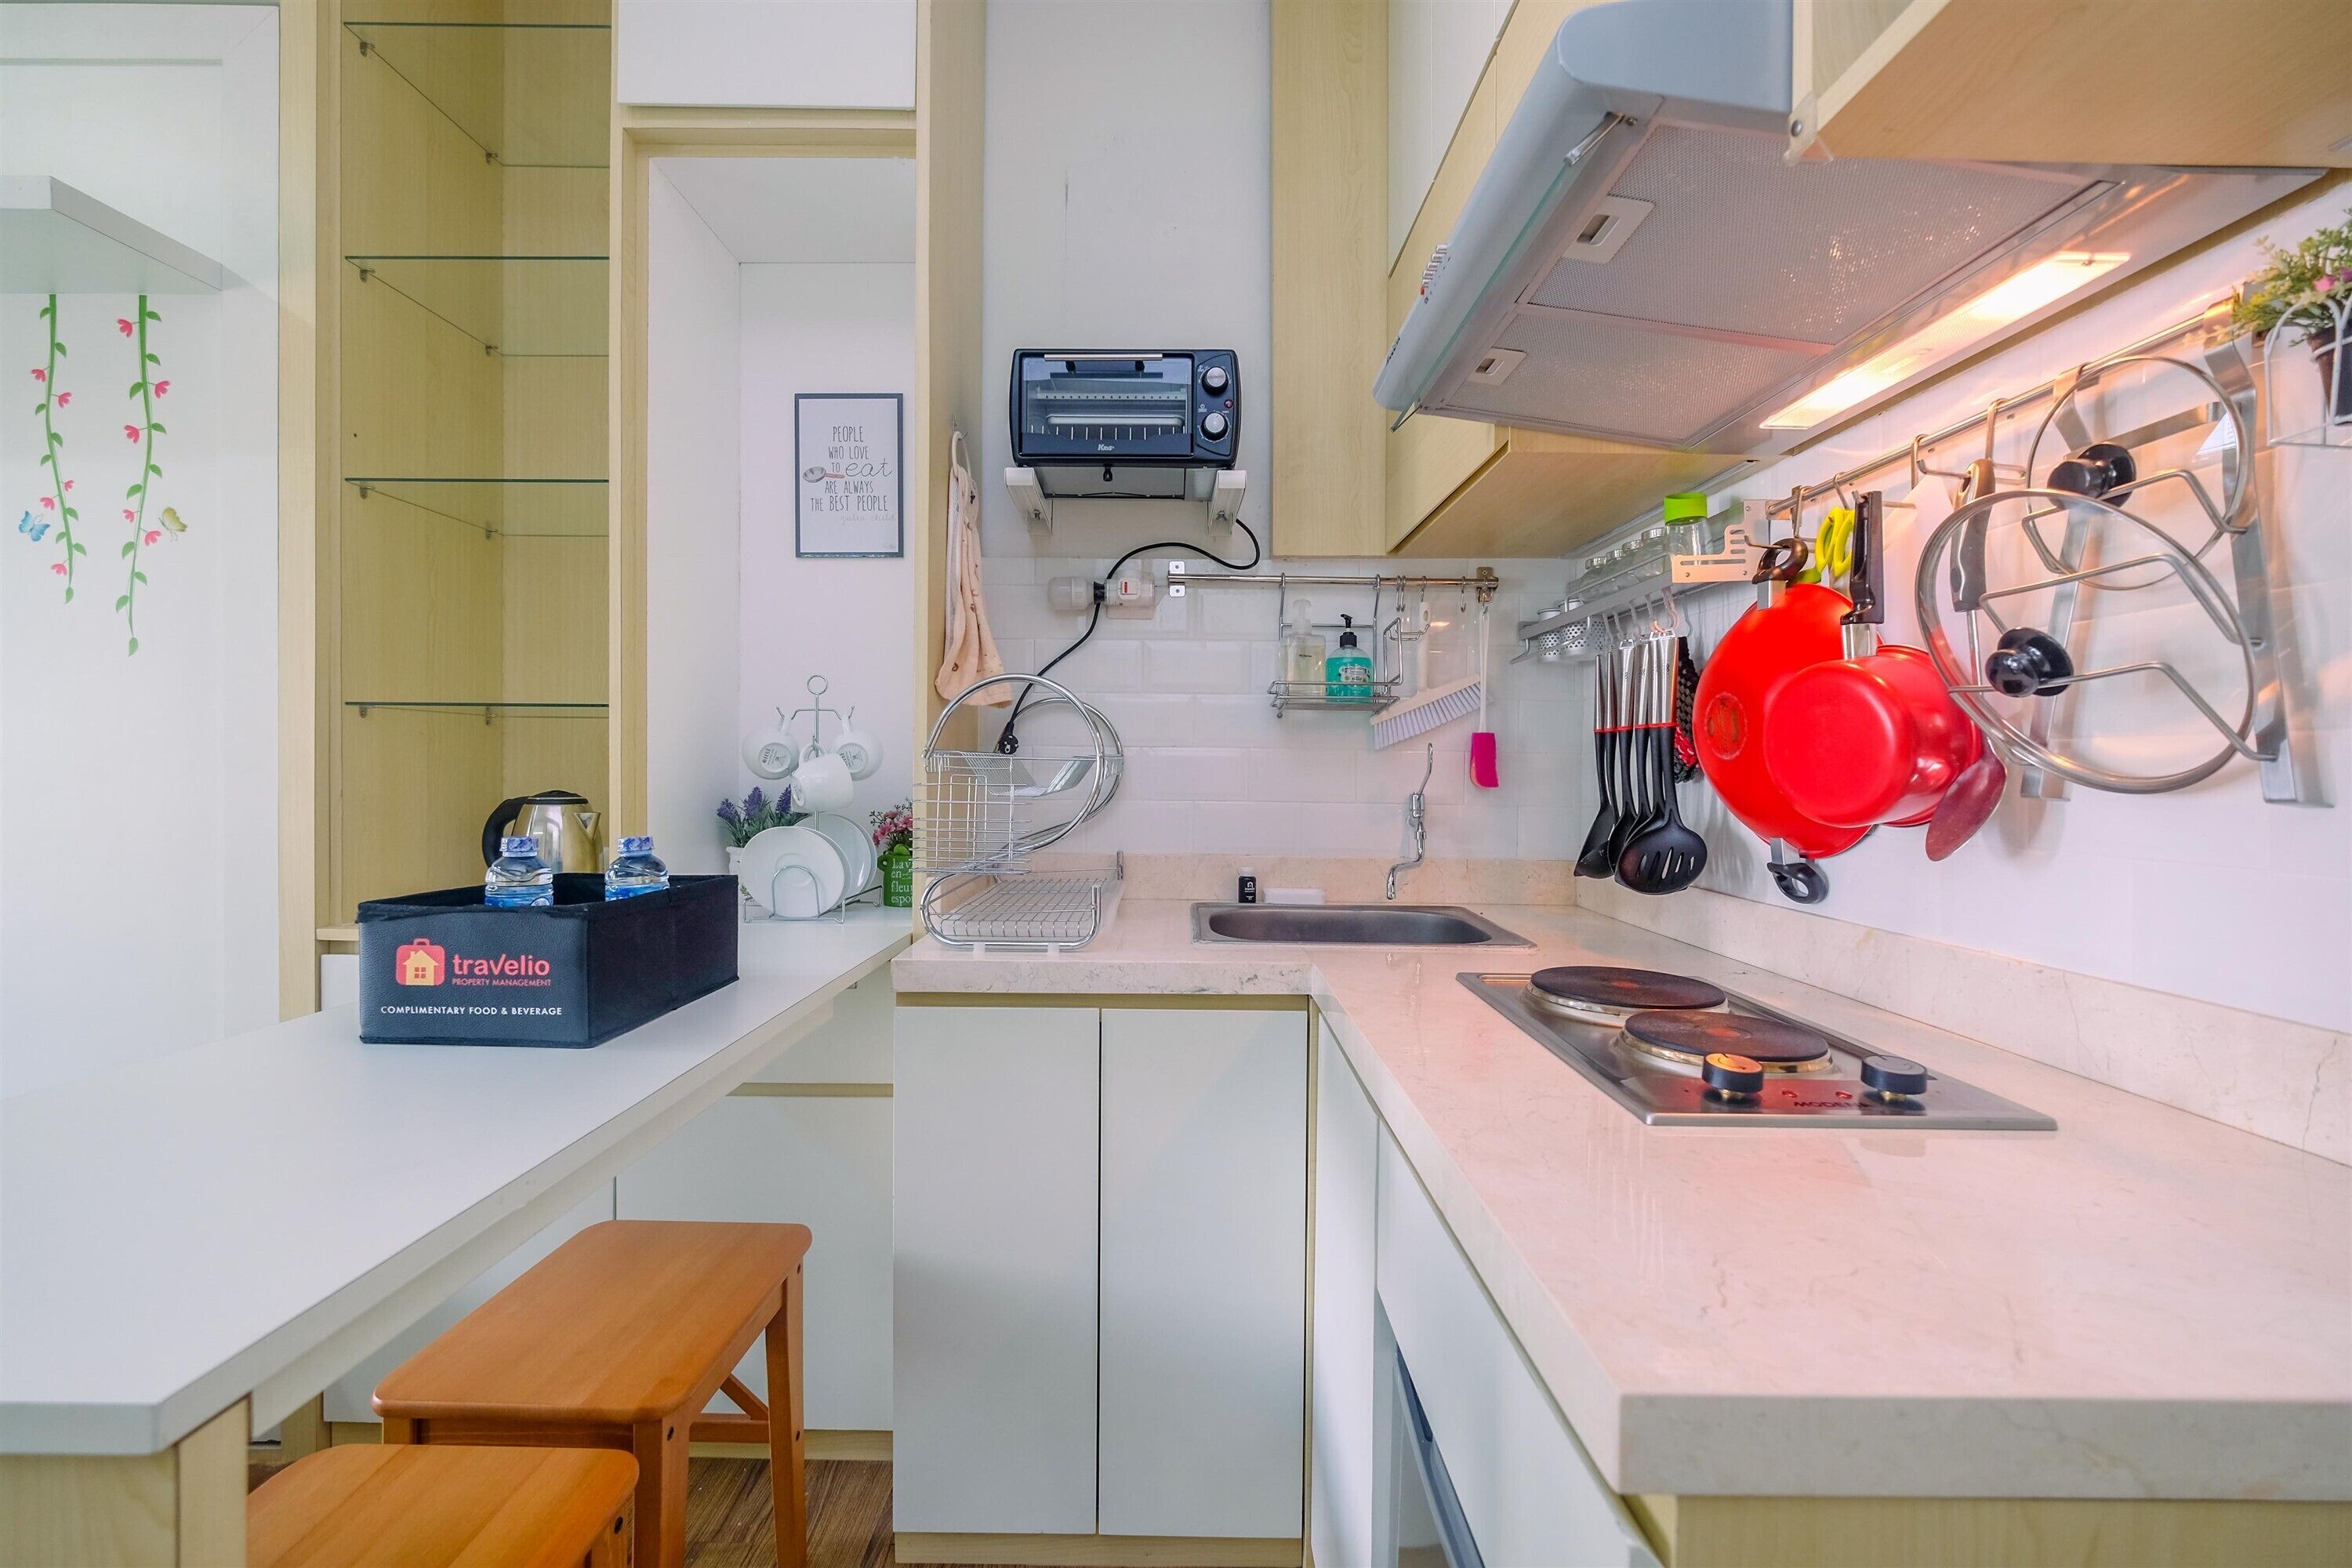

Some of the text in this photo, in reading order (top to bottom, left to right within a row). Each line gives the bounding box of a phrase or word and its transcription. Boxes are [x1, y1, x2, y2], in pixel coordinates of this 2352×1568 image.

[833, 426, 864, 443] PEOPLE
[828, 445, 869, 460] WHO LOVE
[831, 457, 893, 478] TO eat
[824, 481, 874, 495] ARE ALWAYS
[811, 495, 888, 512] THE BEST PEOPLE
[892, 858, 904, 869] La
[452, 953, 550, 976] travelio
[452, 978, 551, 987] PROPERTY MANAGEMENT
[380, 1006, 562, 1016] COMPLIMENTARY FOOD & BEVERAGE
